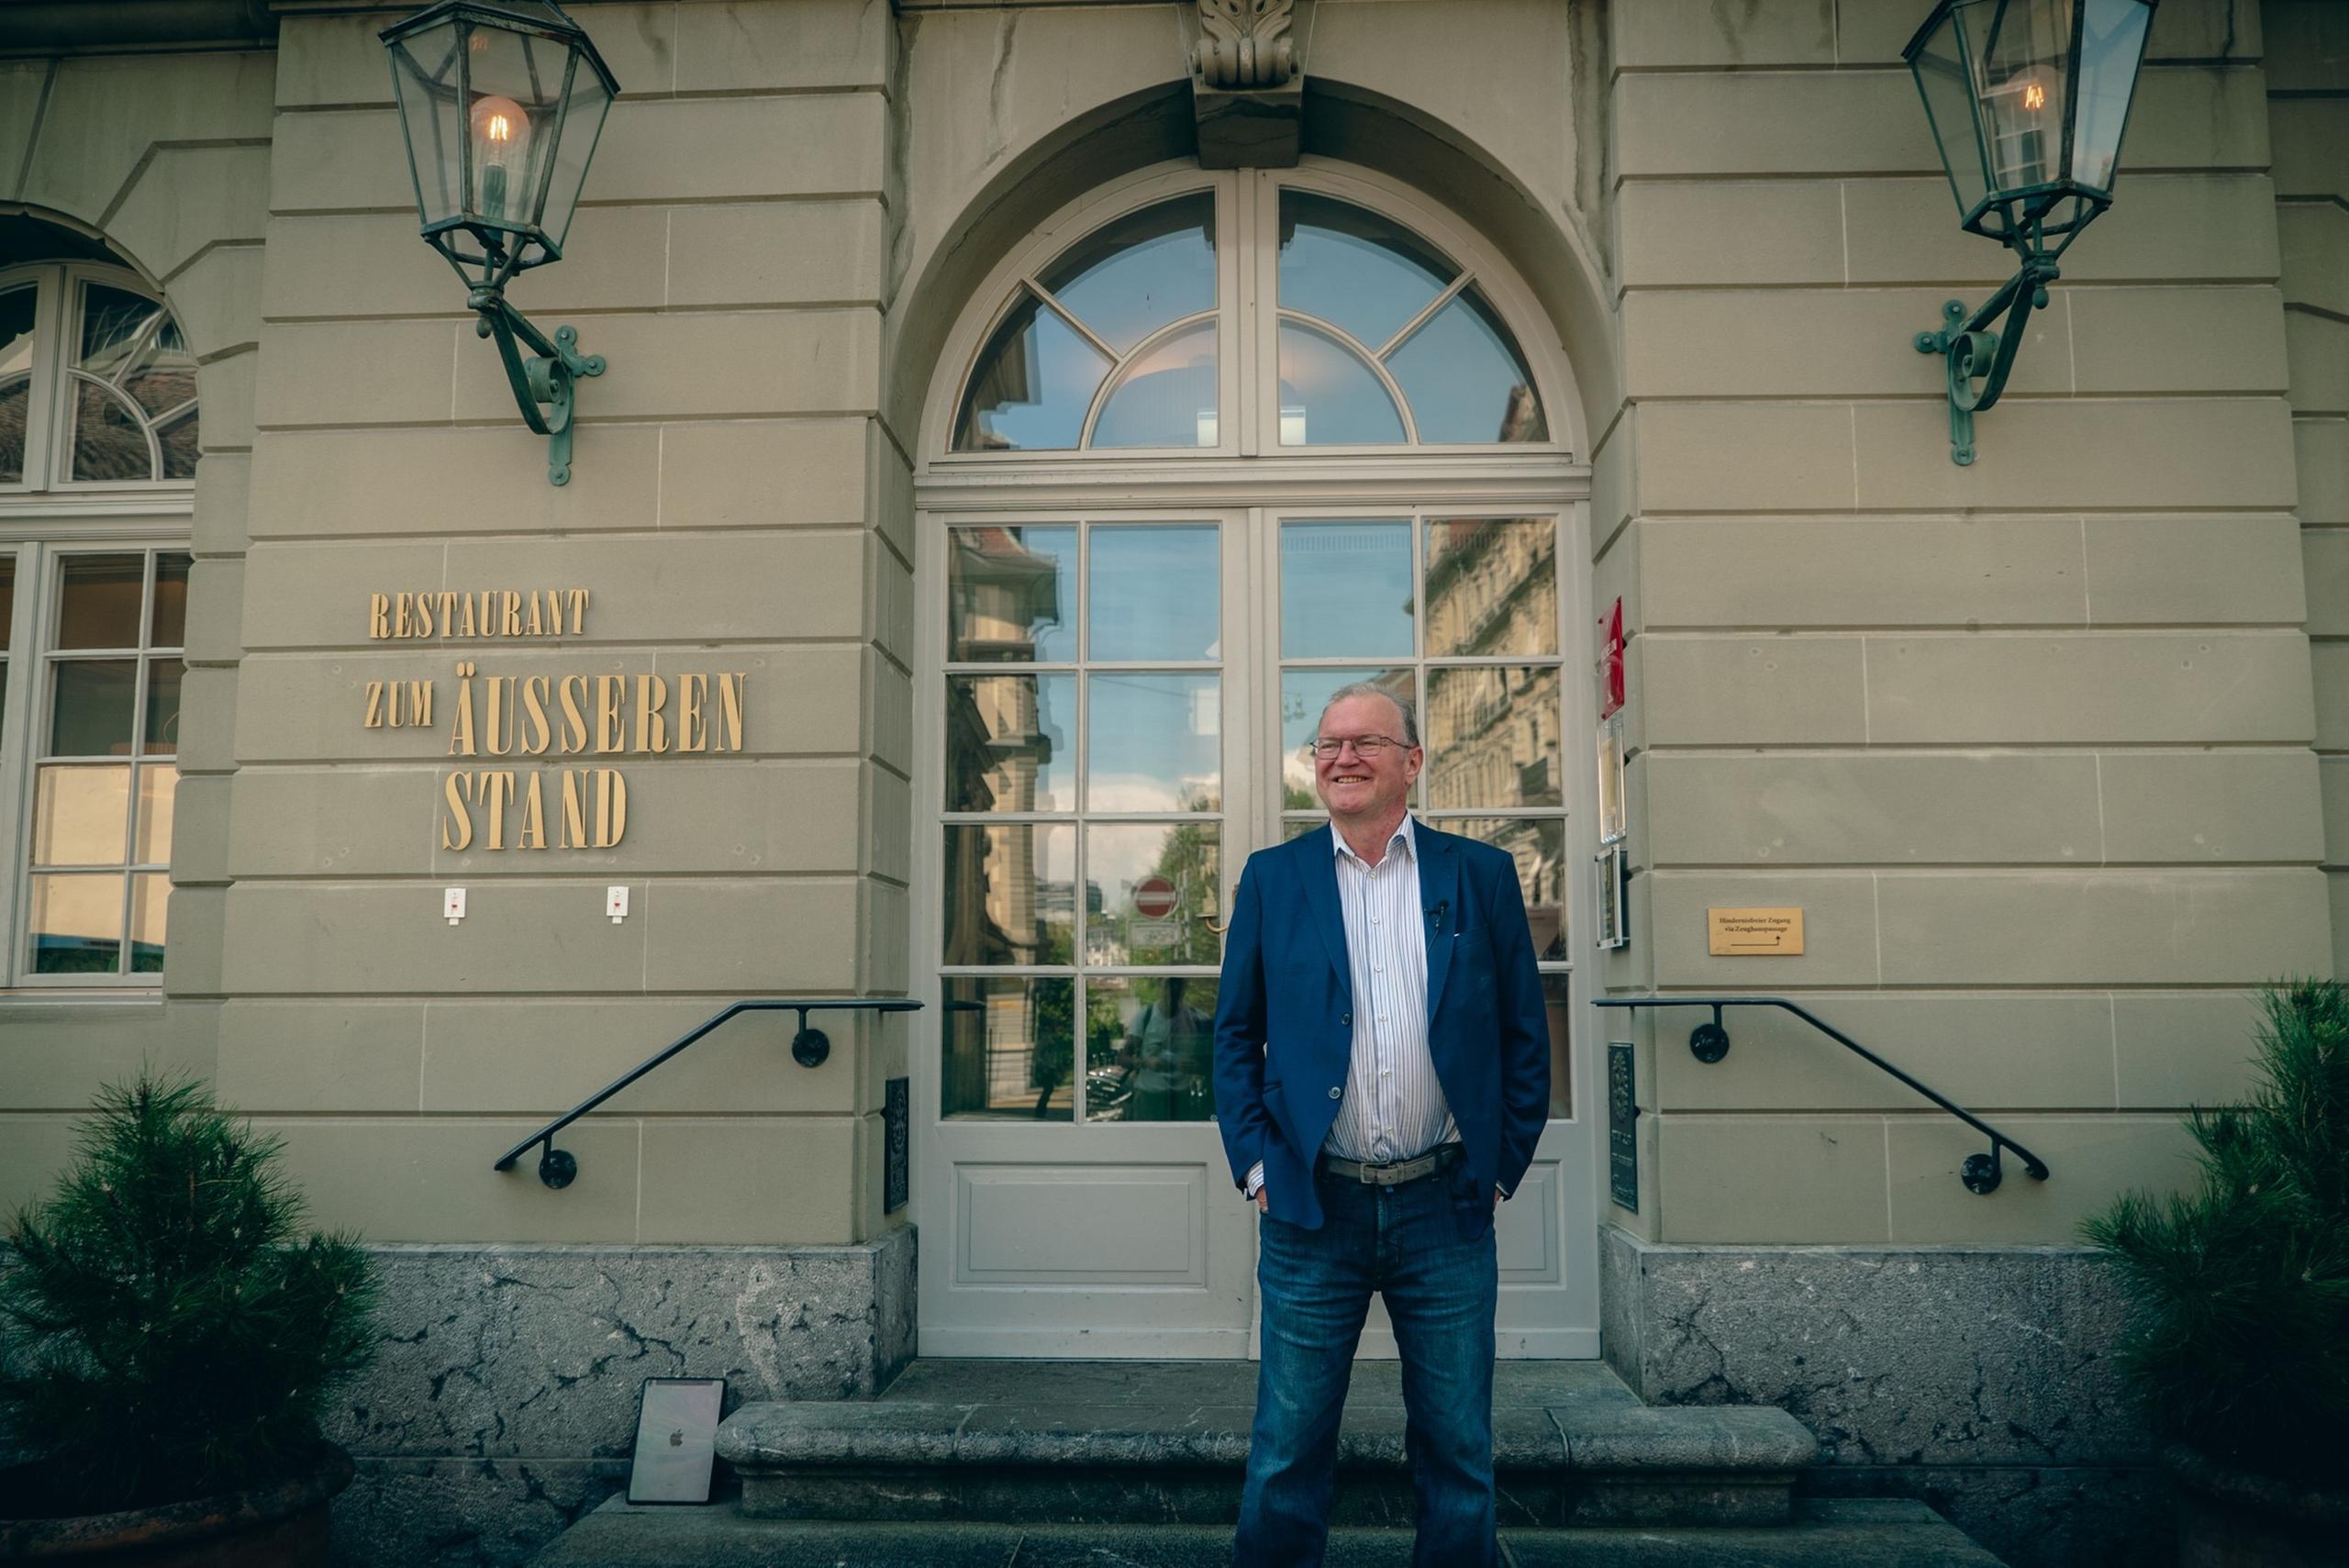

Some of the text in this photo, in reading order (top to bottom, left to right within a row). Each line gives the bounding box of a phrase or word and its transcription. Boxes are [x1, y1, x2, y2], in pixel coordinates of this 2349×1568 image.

[369, 588, 590, 639] RESTAURANT
[364, 661, 748, 755] ZUM ÄUSSEREN
[442, 769, 627, 851] STAND
